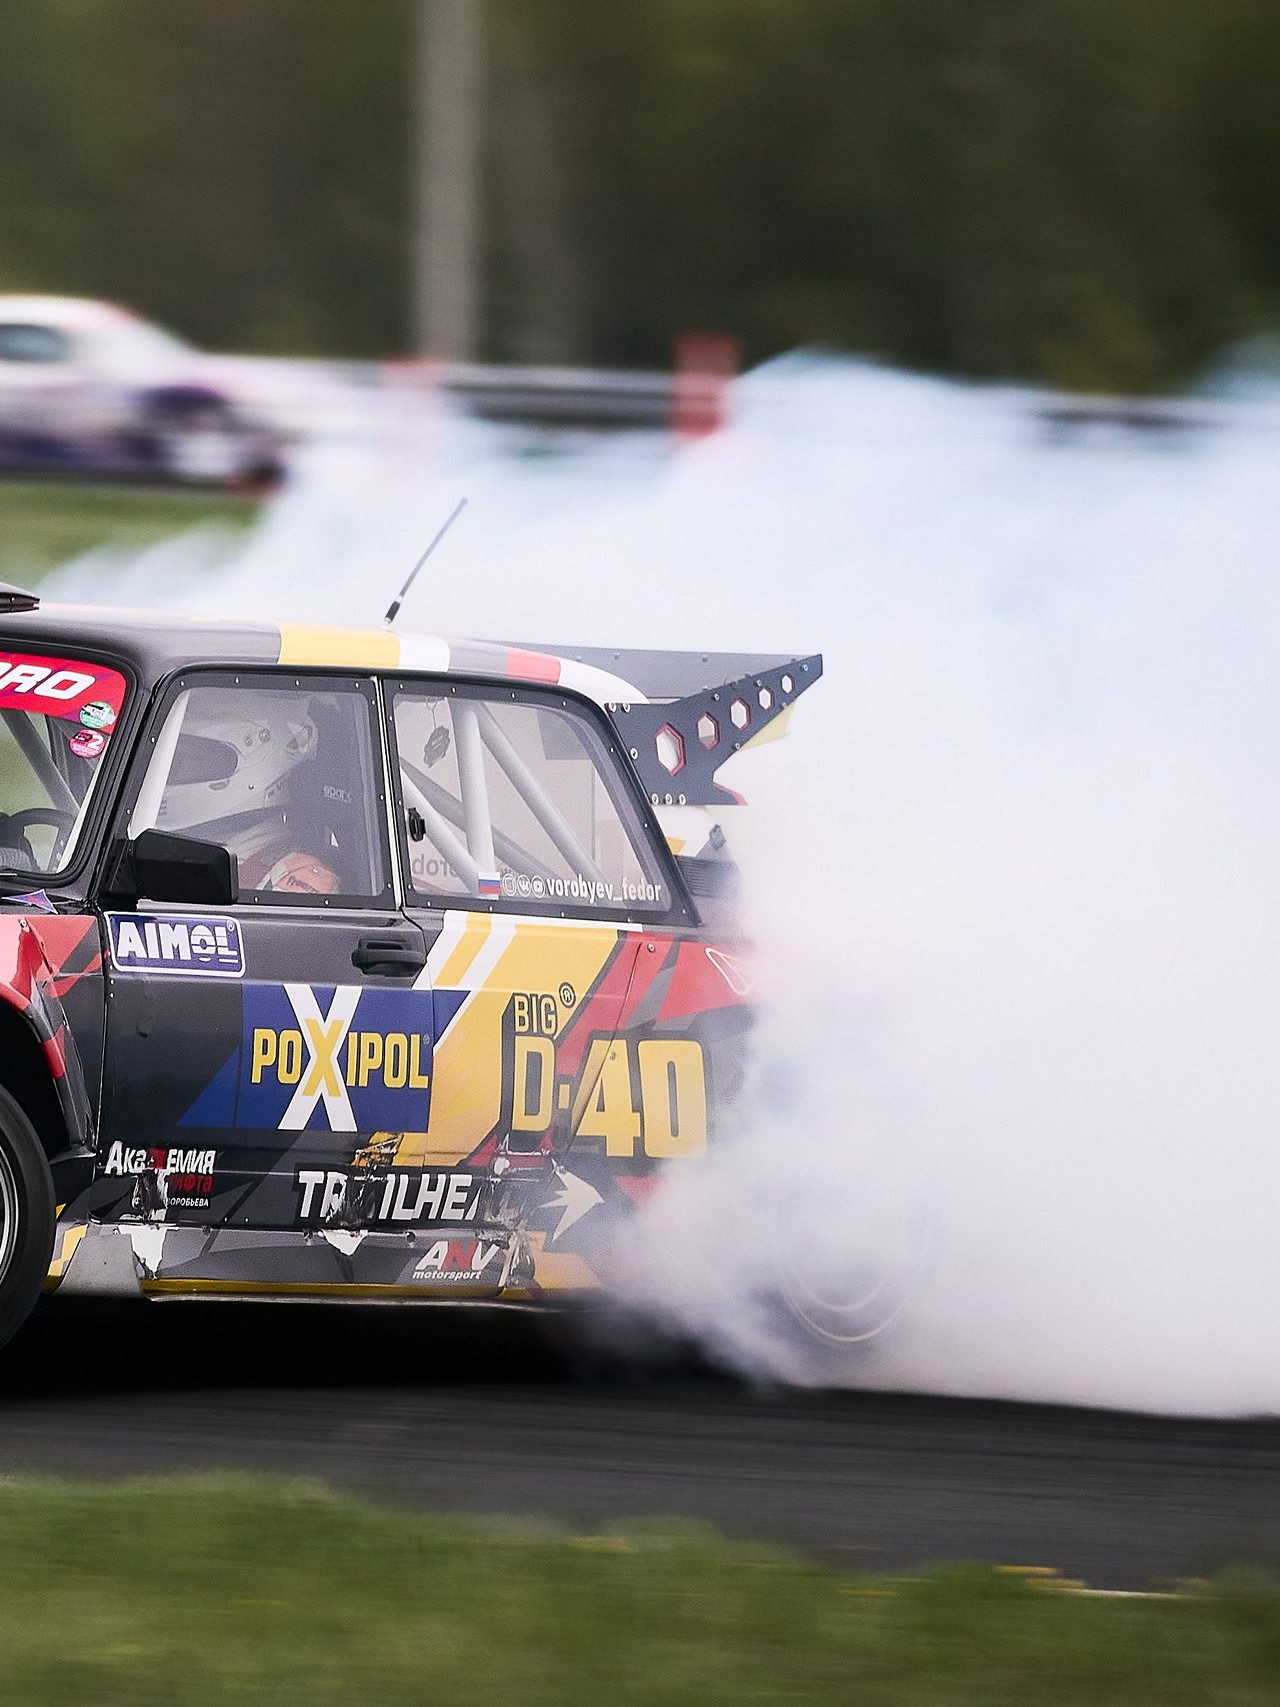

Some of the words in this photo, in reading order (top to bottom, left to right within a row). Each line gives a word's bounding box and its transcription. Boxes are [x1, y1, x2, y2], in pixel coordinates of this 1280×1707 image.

[546, 873, 662, 904] vorobyev_fedor
[117, 921, 239, 964] AIMOL
[513, 993, 558, 1035] BIG
[251, 985, 429, 1132] POXIPOL
[511, 1035, 707, 1158] D-40
[166, 1197, 209, 1207] ОРОБЬЕВА
[415, 1240, 500, 1271] ANV
[412, 1269, 483, 1281] motorsport
